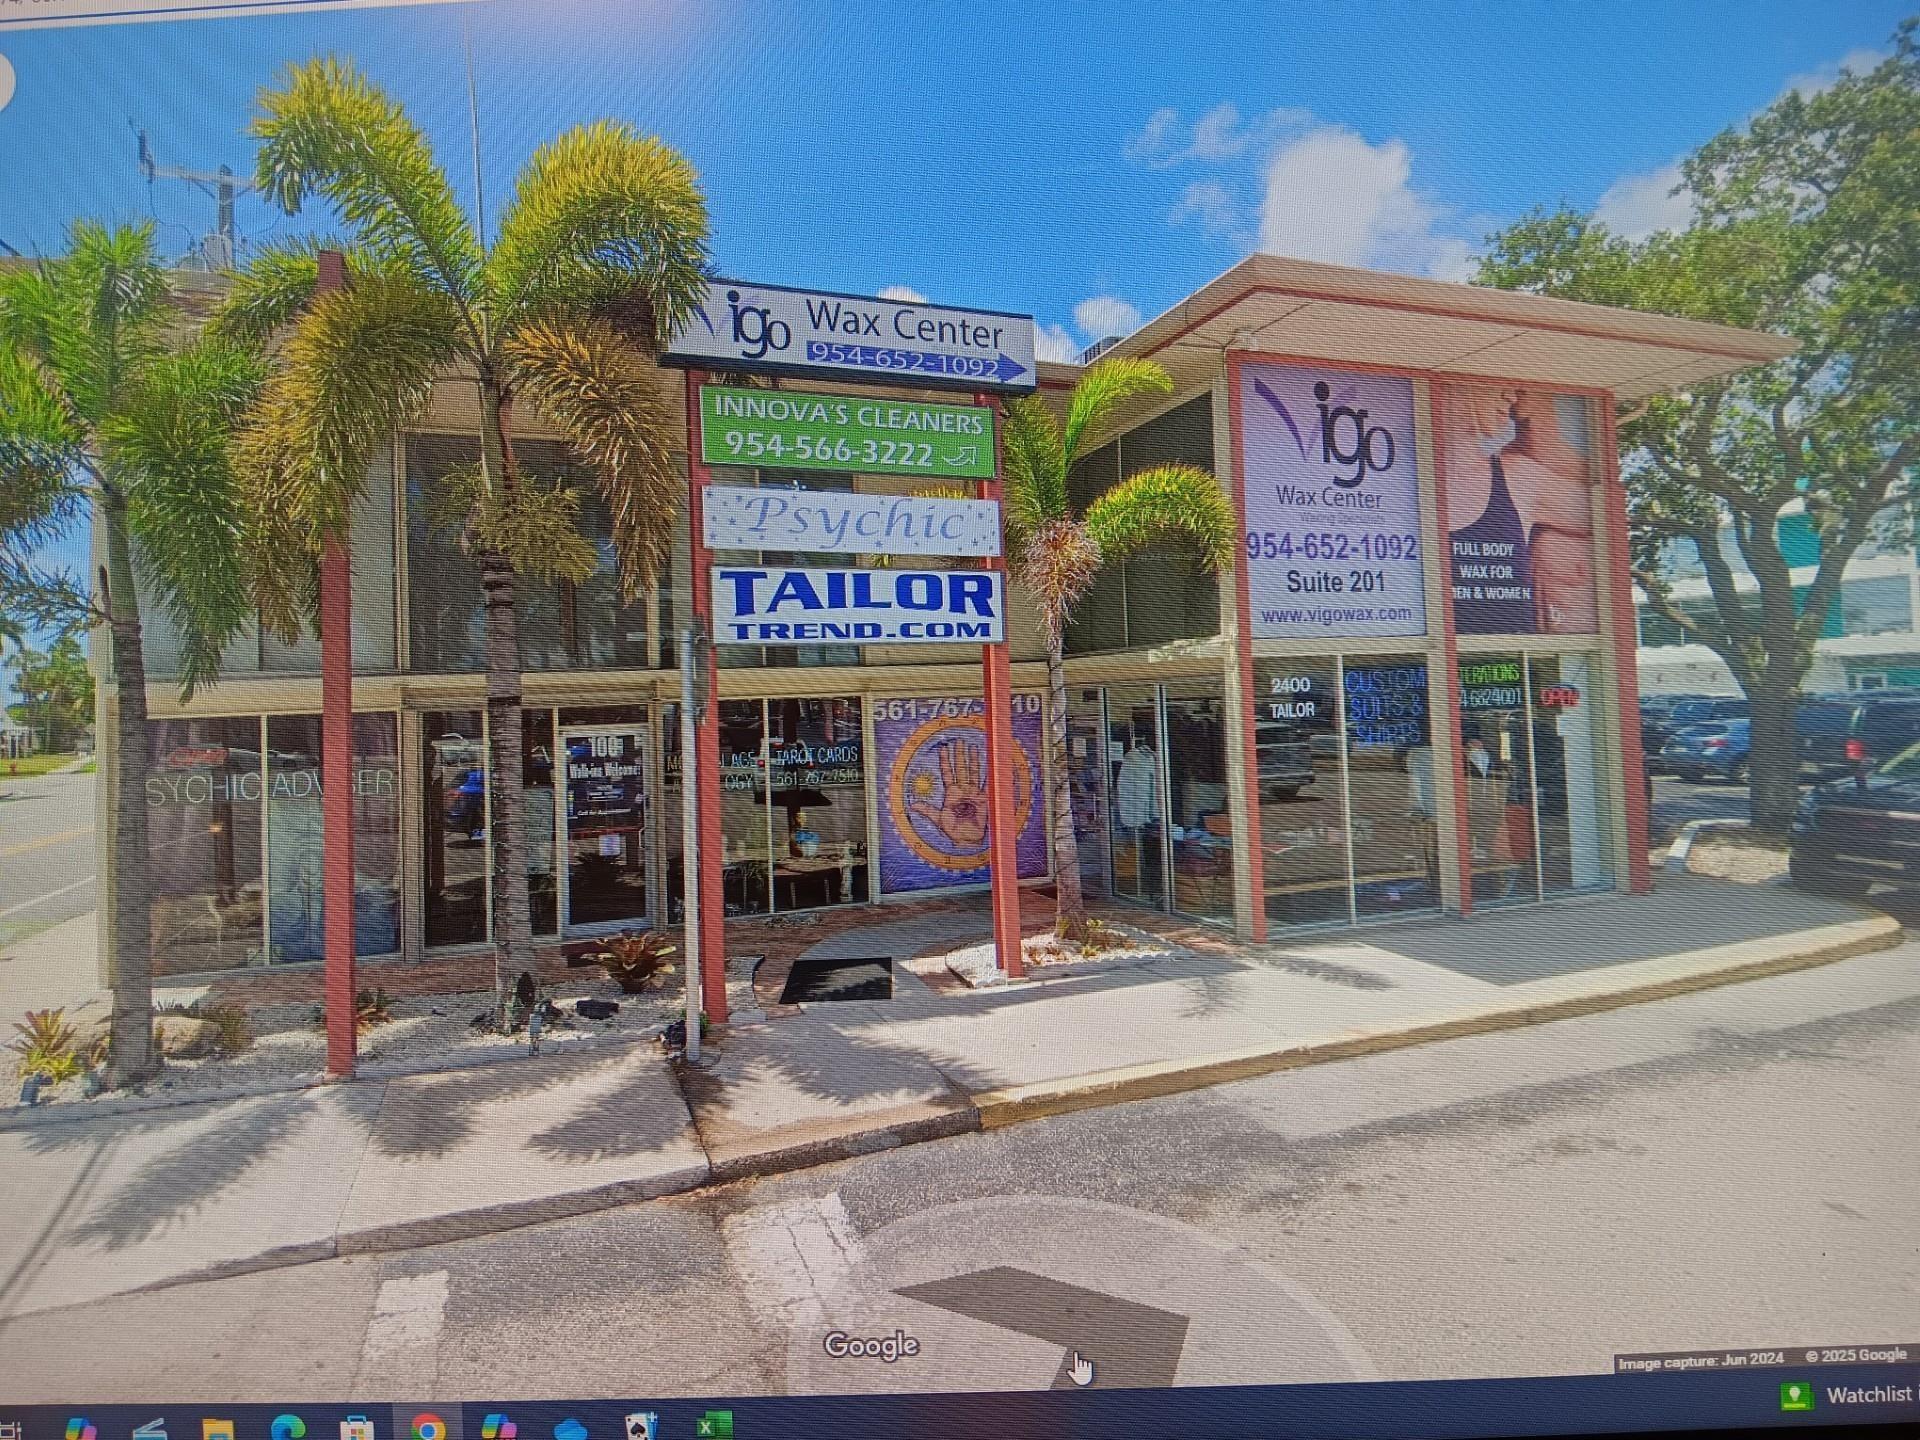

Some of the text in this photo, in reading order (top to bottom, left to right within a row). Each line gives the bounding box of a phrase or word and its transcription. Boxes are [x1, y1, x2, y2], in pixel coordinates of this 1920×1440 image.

[806, 298, 1004, 350] Wax Center
[811, 343, 1001, 380] 954-652-1092
[715, 394, 984, 435] INNOVA'S CLEANERS
[1254, 376, 1396, 489] Vigo
[724, 431, 933, 468] 954-566-3222
[1276, 485, 1382, 509] Wax Center
[744, 496, 966, 550] Psychic
[1246, 531, 1418, 561] 954-652-1092
[1452, 542, 1515, 557] FULL BODY
[1286, 570, 1384, 593] Suite 201
[1459, 564, 1514, 579] WAX FOR
[719, 570, 996, 618] TAILOR
[1473, 586, 1484, 599] &
[1485, 586, 1532, 600] WOMEN
[1261, 606, 1412, 627] www.vigowax.com
[727, 621, 991, 640] TREND.COM
[1271, 677, 1311, 693] 2400
[1345, 667, 1426, 693] CUSTOM
[1459, 663, 1520, 684] TERATIONS
[873, 694, 1040, 721] 561-767-10
[1350, 693, 1424, 720] SUITS &
[1540, 687, 1581, 707] OPEN
[1270, 702, 1316, 719] TAILOR
[816, 745, 858, 764] CARDS
[145, 772, 262, 807] SYCHIC
[822, 1329, 921, 1364] Google
[1619, 1357, 1661, 1372] Image
[1664, 1356, 1719, 1370] capture:
[1721, 1353, 1747, 1367] Jun
[1750, 1351, 1785, 1365] 2024
[1821, 1349, 1857, 1362] 2025
[1859, 1347, 1907, 1363] Google
[1826, 1385, 1913, 1405] Watchlist
